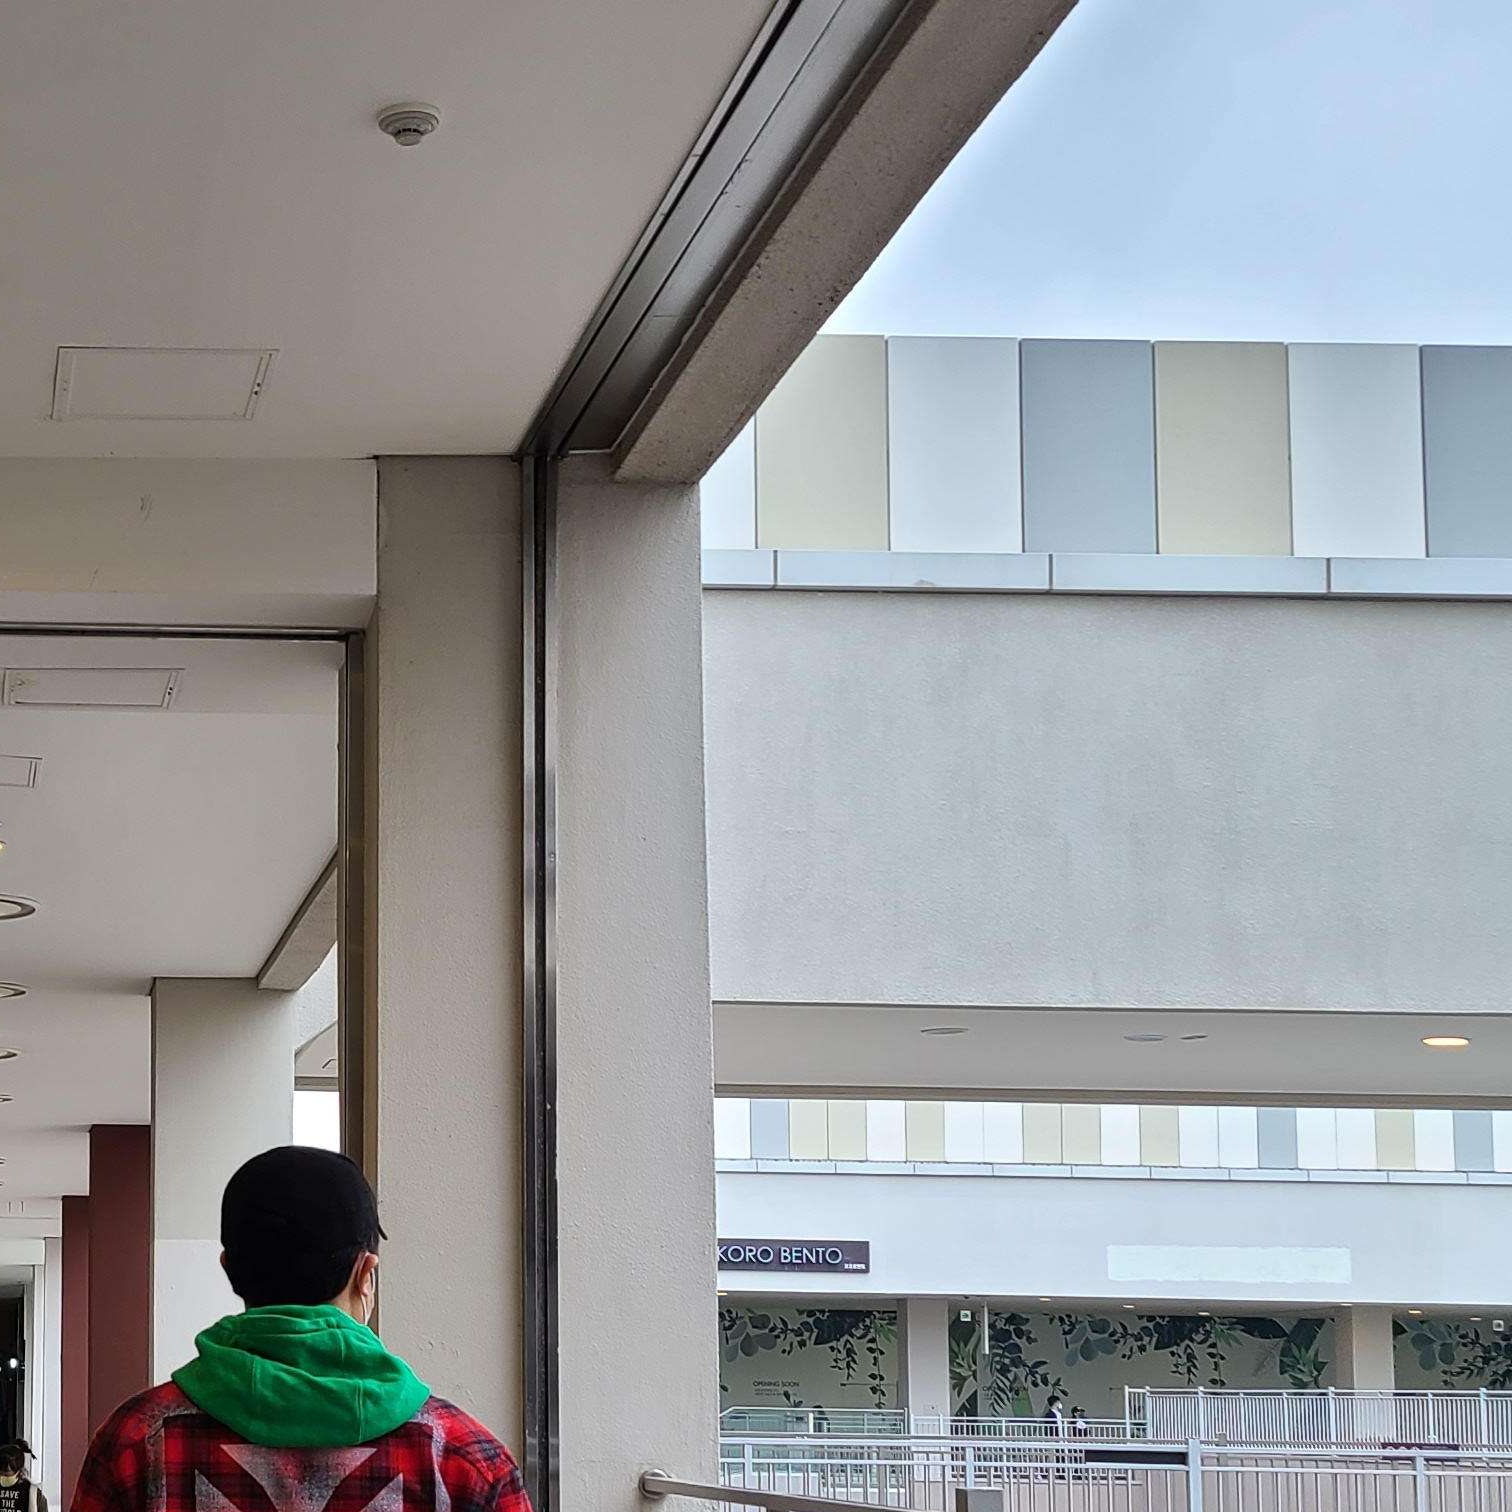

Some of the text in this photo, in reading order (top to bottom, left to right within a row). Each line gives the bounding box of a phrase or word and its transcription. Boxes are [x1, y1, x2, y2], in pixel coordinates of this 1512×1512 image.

[780, 1246, 843, 1264] BENTO
[752, 1380, 800, 1388] OPENING SOON
[0, 1490, 20, 1499] SAVE
[1, 1499, 16, 1509] THE
